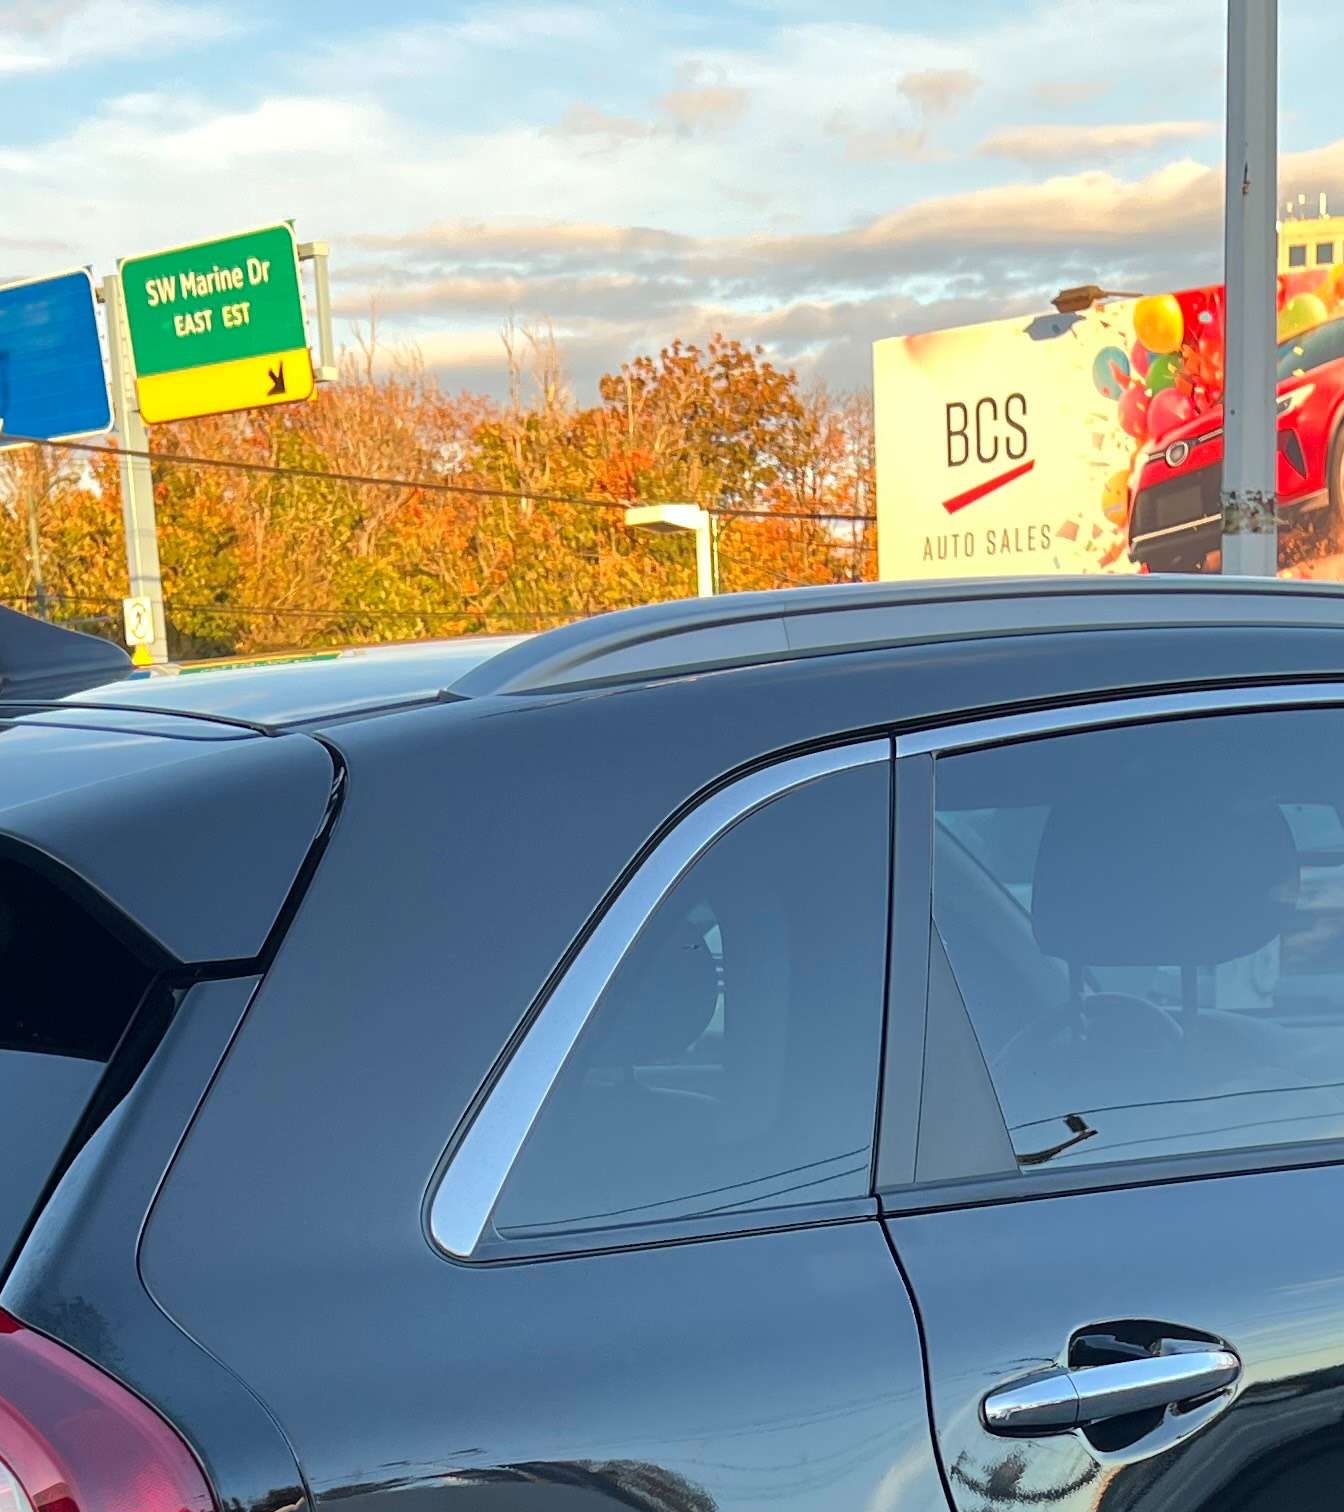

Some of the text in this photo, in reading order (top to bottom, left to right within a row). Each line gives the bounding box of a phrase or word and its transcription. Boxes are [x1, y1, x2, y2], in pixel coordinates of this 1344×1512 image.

[145, 256, 271, 308] SW Marine Dr
[174, 301, 251, 338] EAST EST
[945, 391, 1028, 468] BCS
[922, 522, 1052, 563] AUTO SALES
